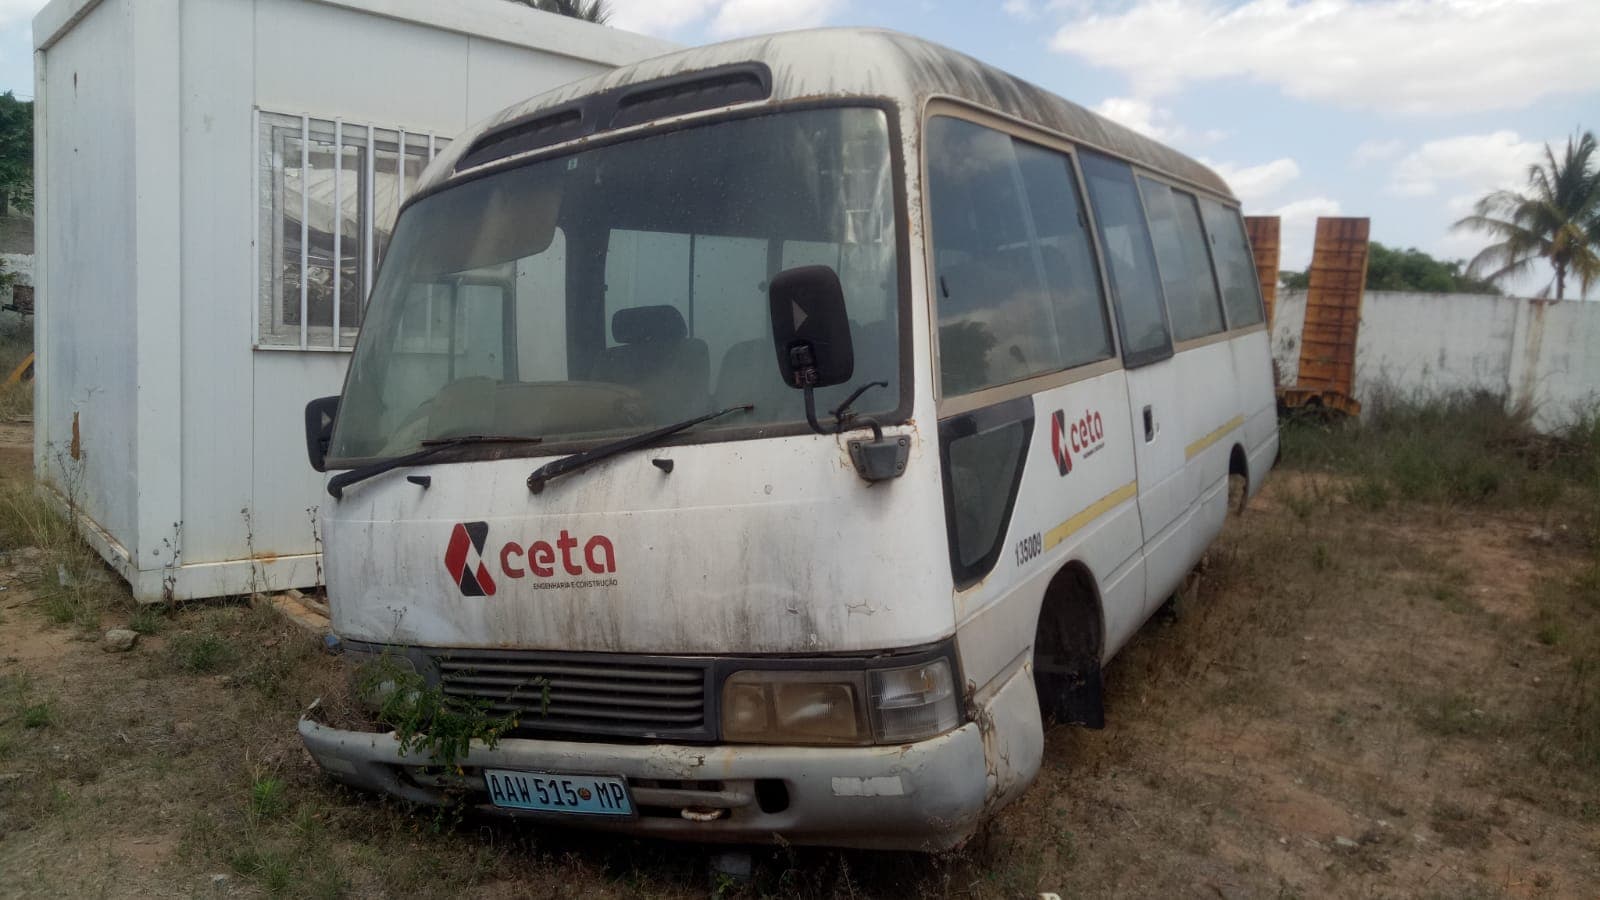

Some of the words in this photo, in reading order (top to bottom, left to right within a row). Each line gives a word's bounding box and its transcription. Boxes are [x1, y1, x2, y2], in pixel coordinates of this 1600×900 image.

[1070, 409, 1104, 453] ceta
[500, 530, 616, 578] ceta
[1015, 532, 1041, 567] 135009
[575, 577, 618, 588] CONSTRUÇÃO
[490, 774, 531, 803] AAW
[533, 778, 579, 806] 515
[594, 781, 625, 808] MP
